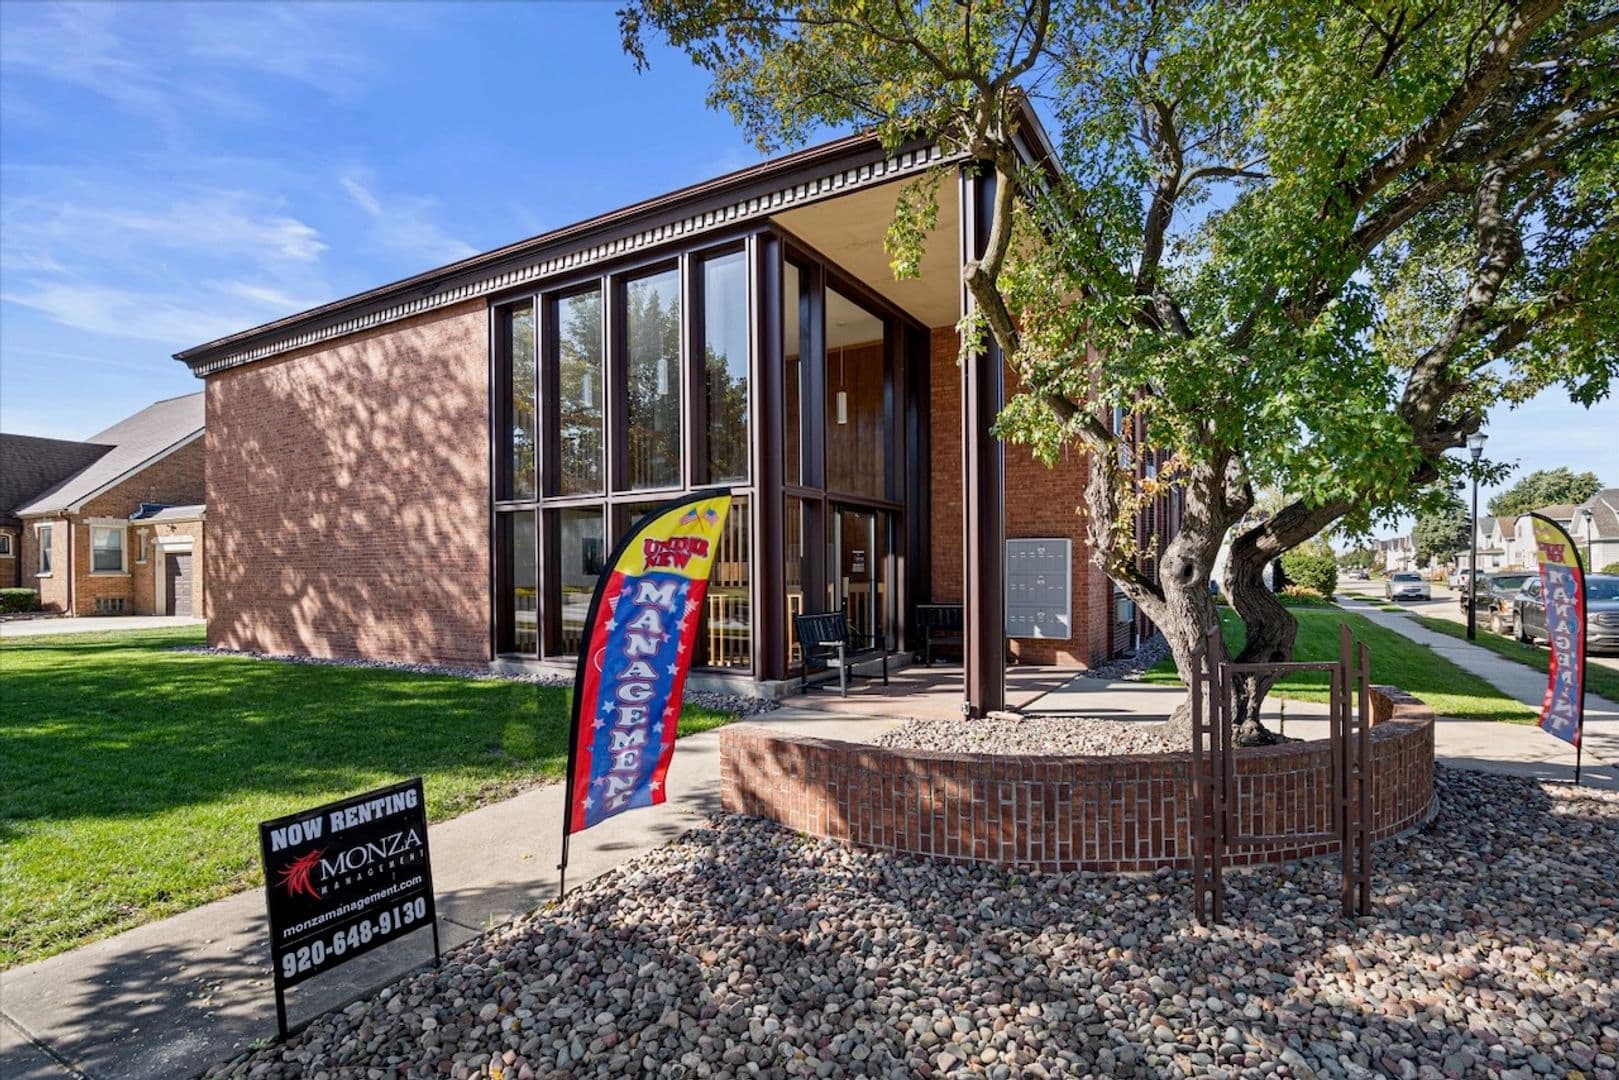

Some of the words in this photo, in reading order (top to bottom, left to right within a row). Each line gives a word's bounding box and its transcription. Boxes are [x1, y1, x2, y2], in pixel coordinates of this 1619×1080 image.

[642, 551, 692, 572] NEW
[271, 816, 323, 852] NOW
[331, 790, 417, 833] RENTING
[320, 828, 424, 881] MONZA
[321, 849, 424, 895] MANAGEMENT
[282, 874, 423, 939] monzamanagement.com
[281, 897, 427, 979] 920-648-9130
